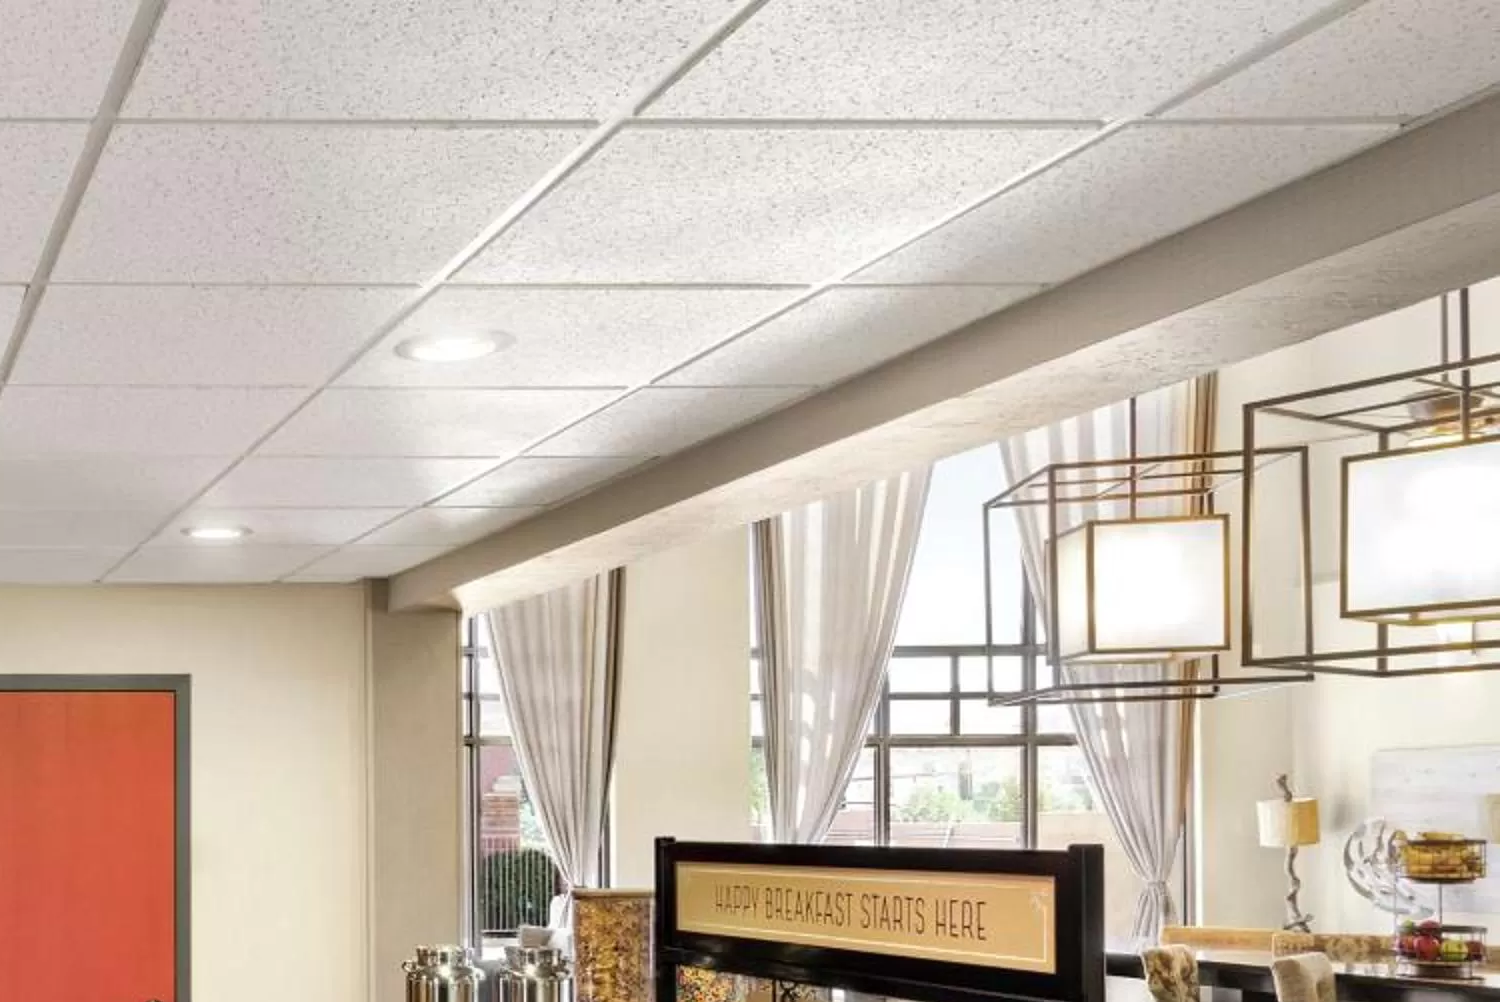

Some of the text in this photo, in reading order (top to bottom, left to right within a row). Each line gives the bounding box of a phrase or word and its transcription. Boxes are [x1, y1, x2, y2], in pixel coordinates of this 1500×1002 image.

[715, 884, 987, 941] HAPPY BREAKFAST STARTS HERE
